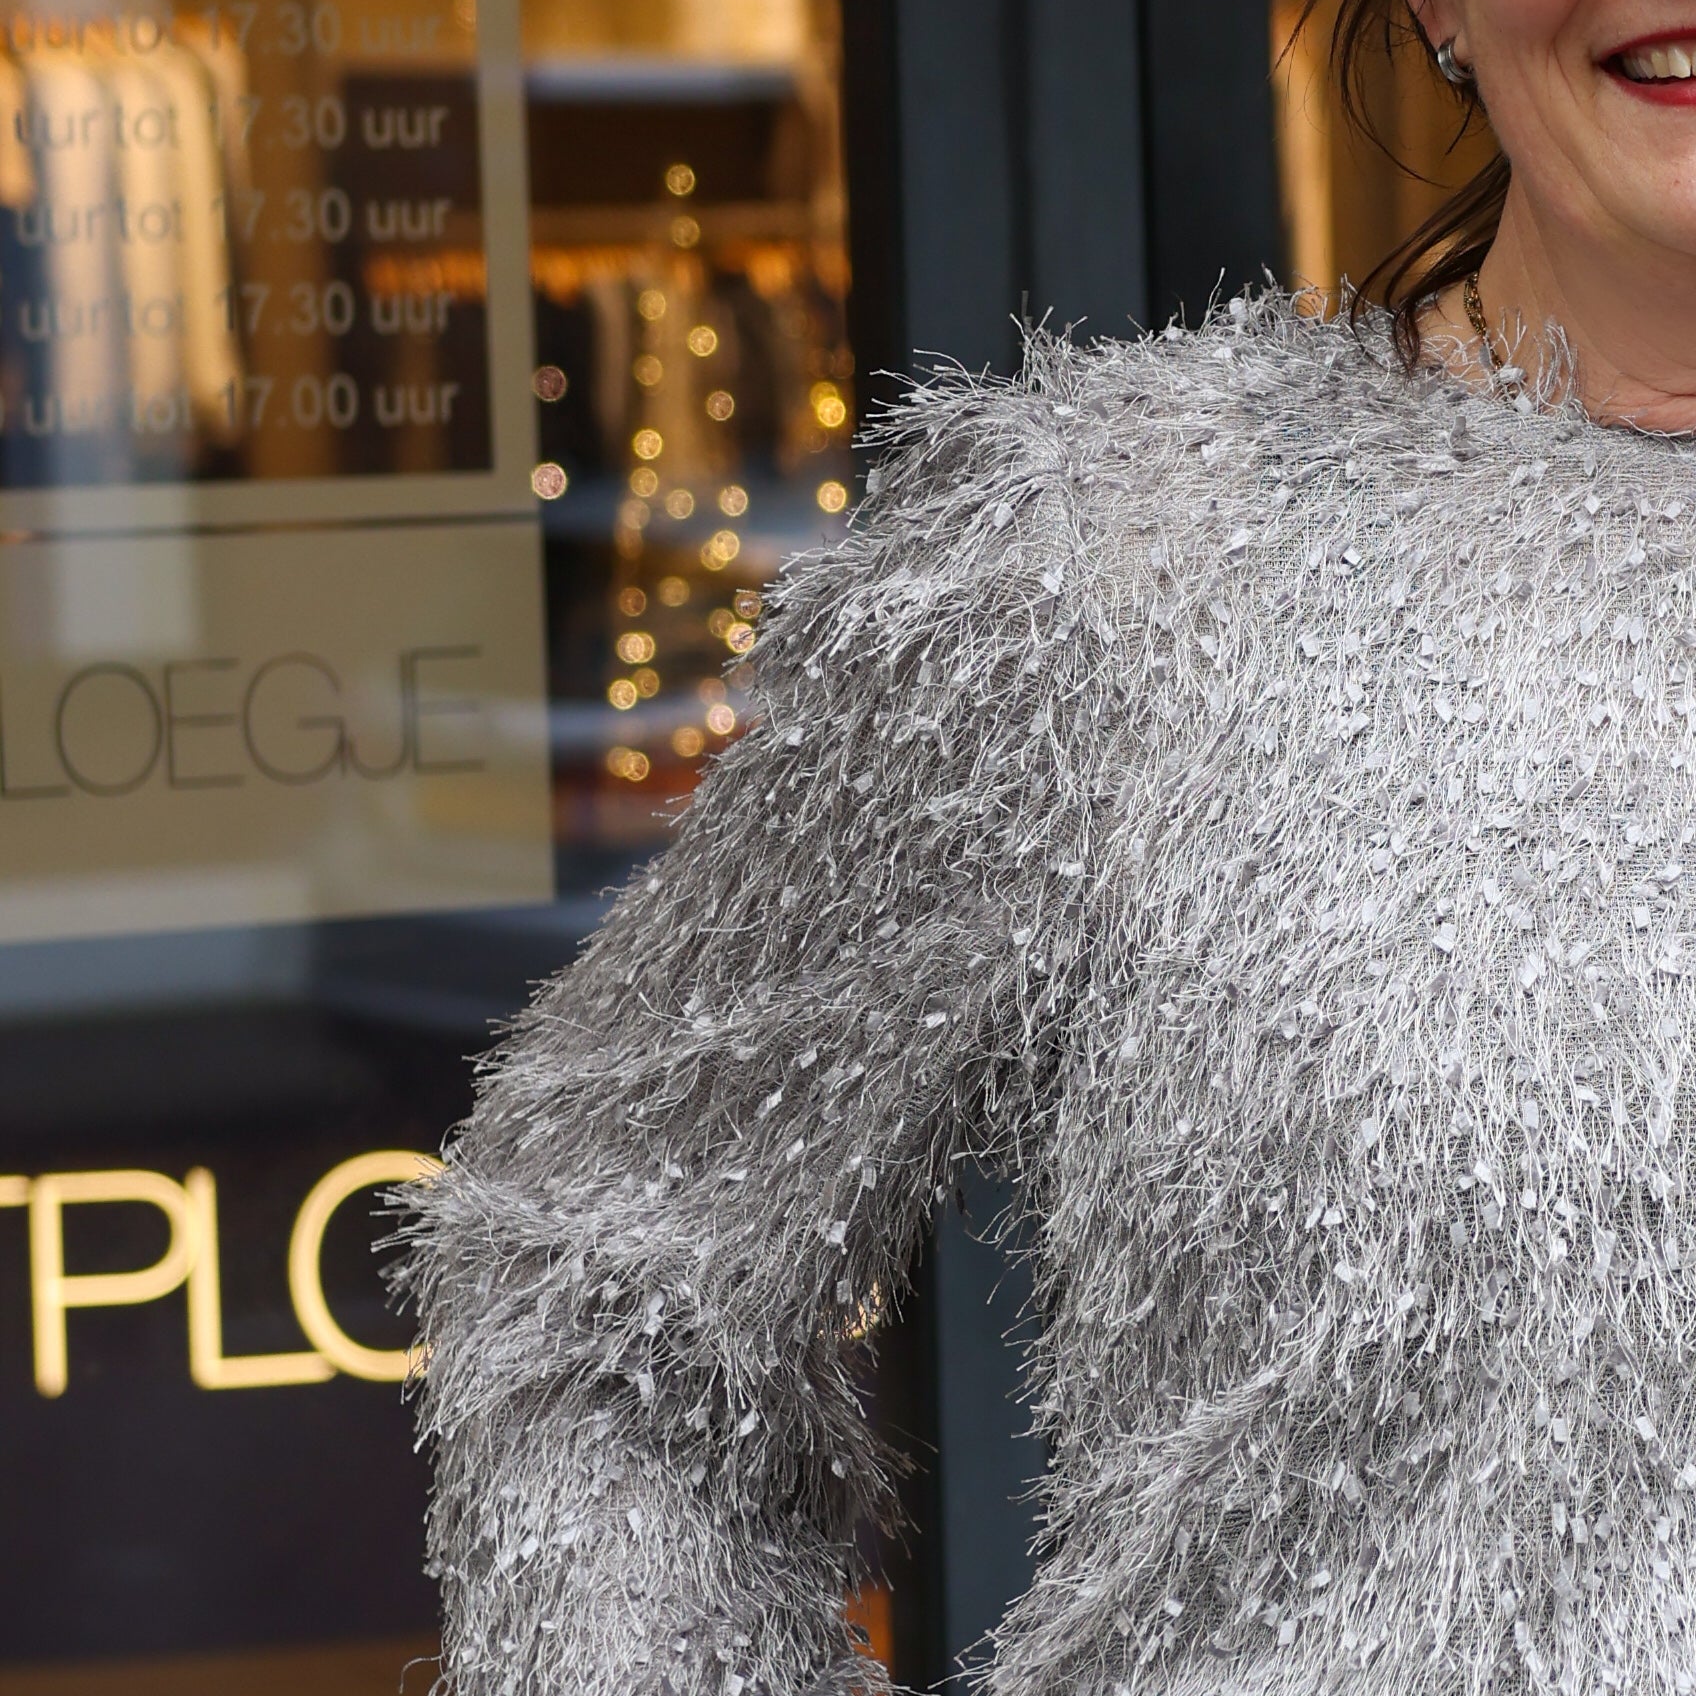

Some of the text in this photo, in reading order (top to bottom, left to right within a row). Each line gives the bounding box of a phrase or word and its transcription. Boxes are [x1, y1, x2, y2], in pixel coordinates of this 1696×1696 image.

[207, 2, 341, 55] 17.30
[358, 16, 441, 52] uur
[15, 95, 449, 151] uur tot 17.30 uur
[18, 188, 451, 246] uur tot 17.30 uur
[20, 296, 104, 341] uur
[213, 281, 355, 337] 17.30
[371, 290, 457, 333] uur
[23, 391, 104, 436] uur
[217, 375, 359, 429] 17.00
[375, 382, 460, 426] uur
